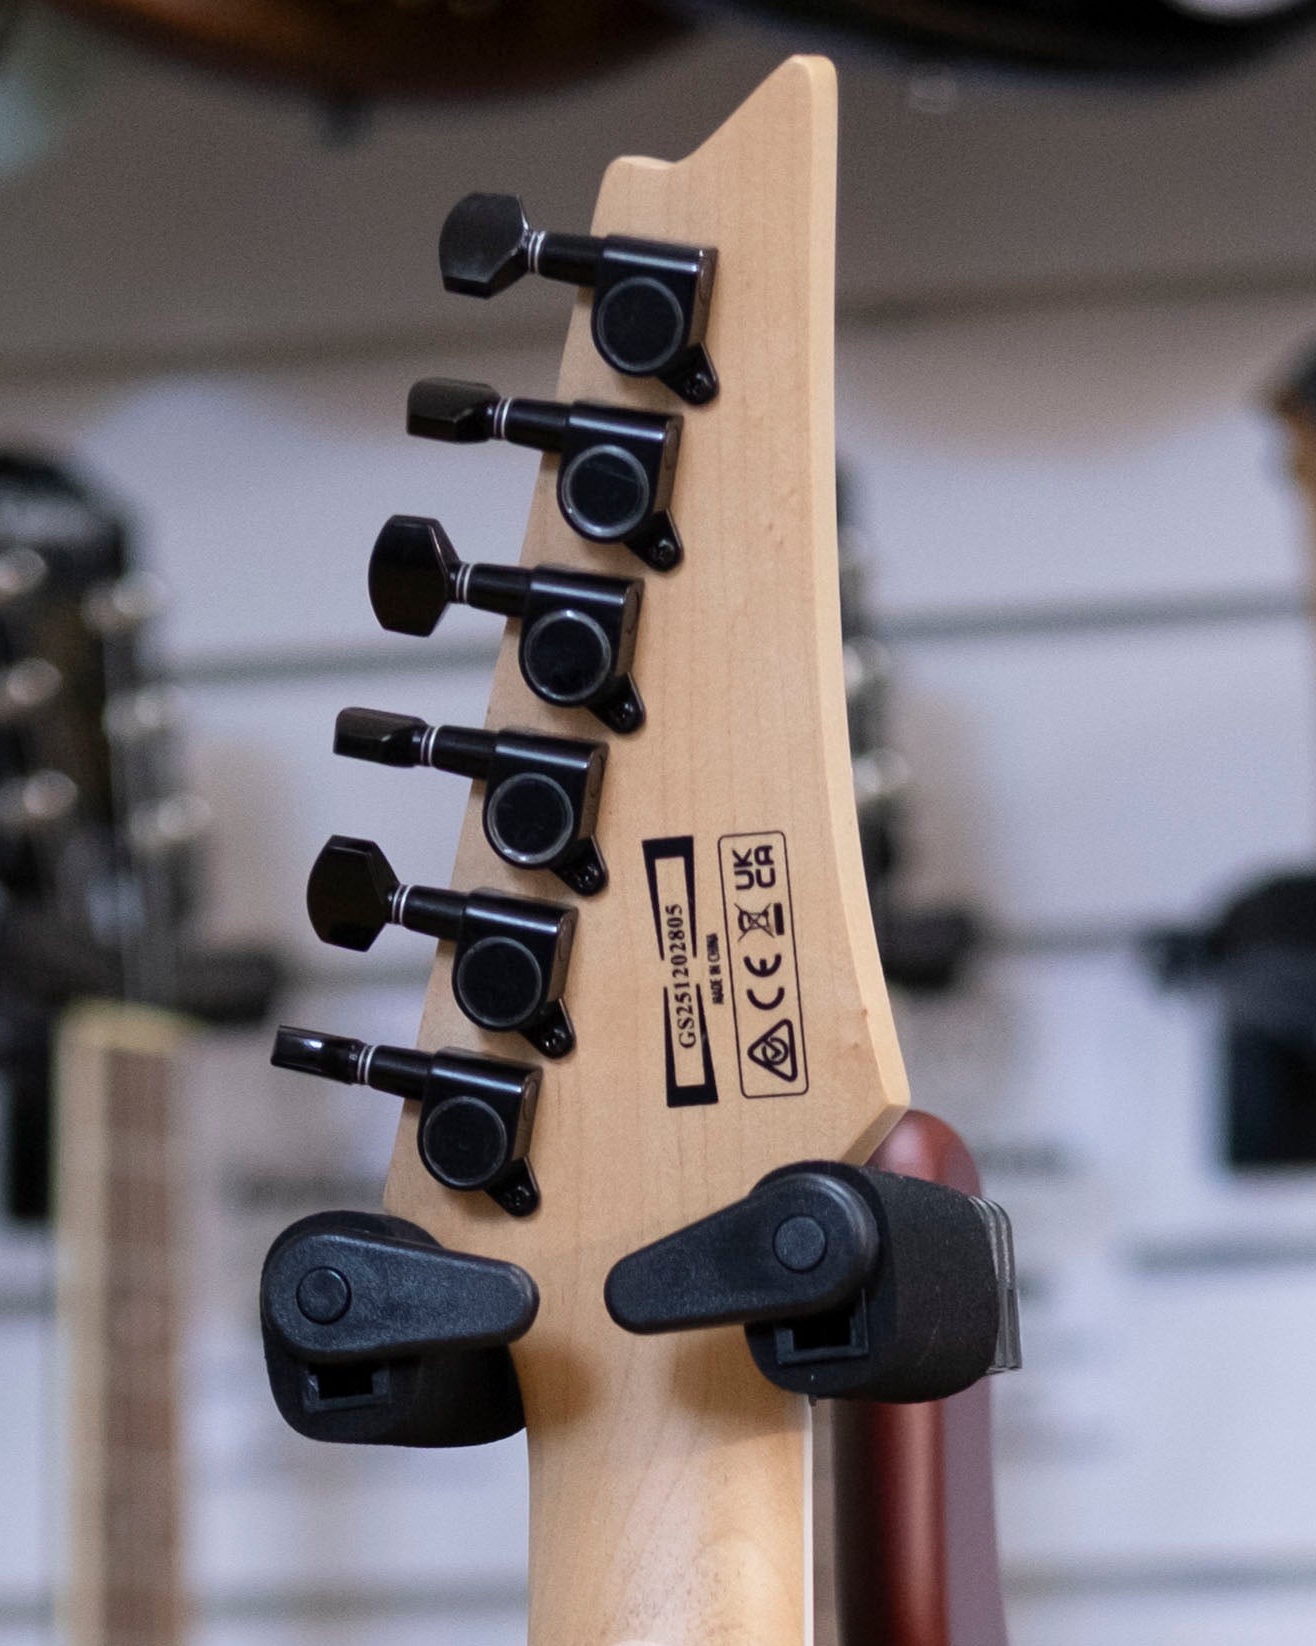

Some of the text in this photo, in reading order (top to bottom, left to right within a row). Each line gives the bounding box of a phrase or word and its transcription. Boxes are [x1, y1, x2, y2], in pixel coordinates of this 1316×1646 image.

[732, 848, 755, 890] UK
[754, 845, 776, 889] CA
[665, 904, 696, 1049] GS251202805
[706, 933, 724, 1005] MADE IN CHINA
[745, 953, 785, 1010] CE
